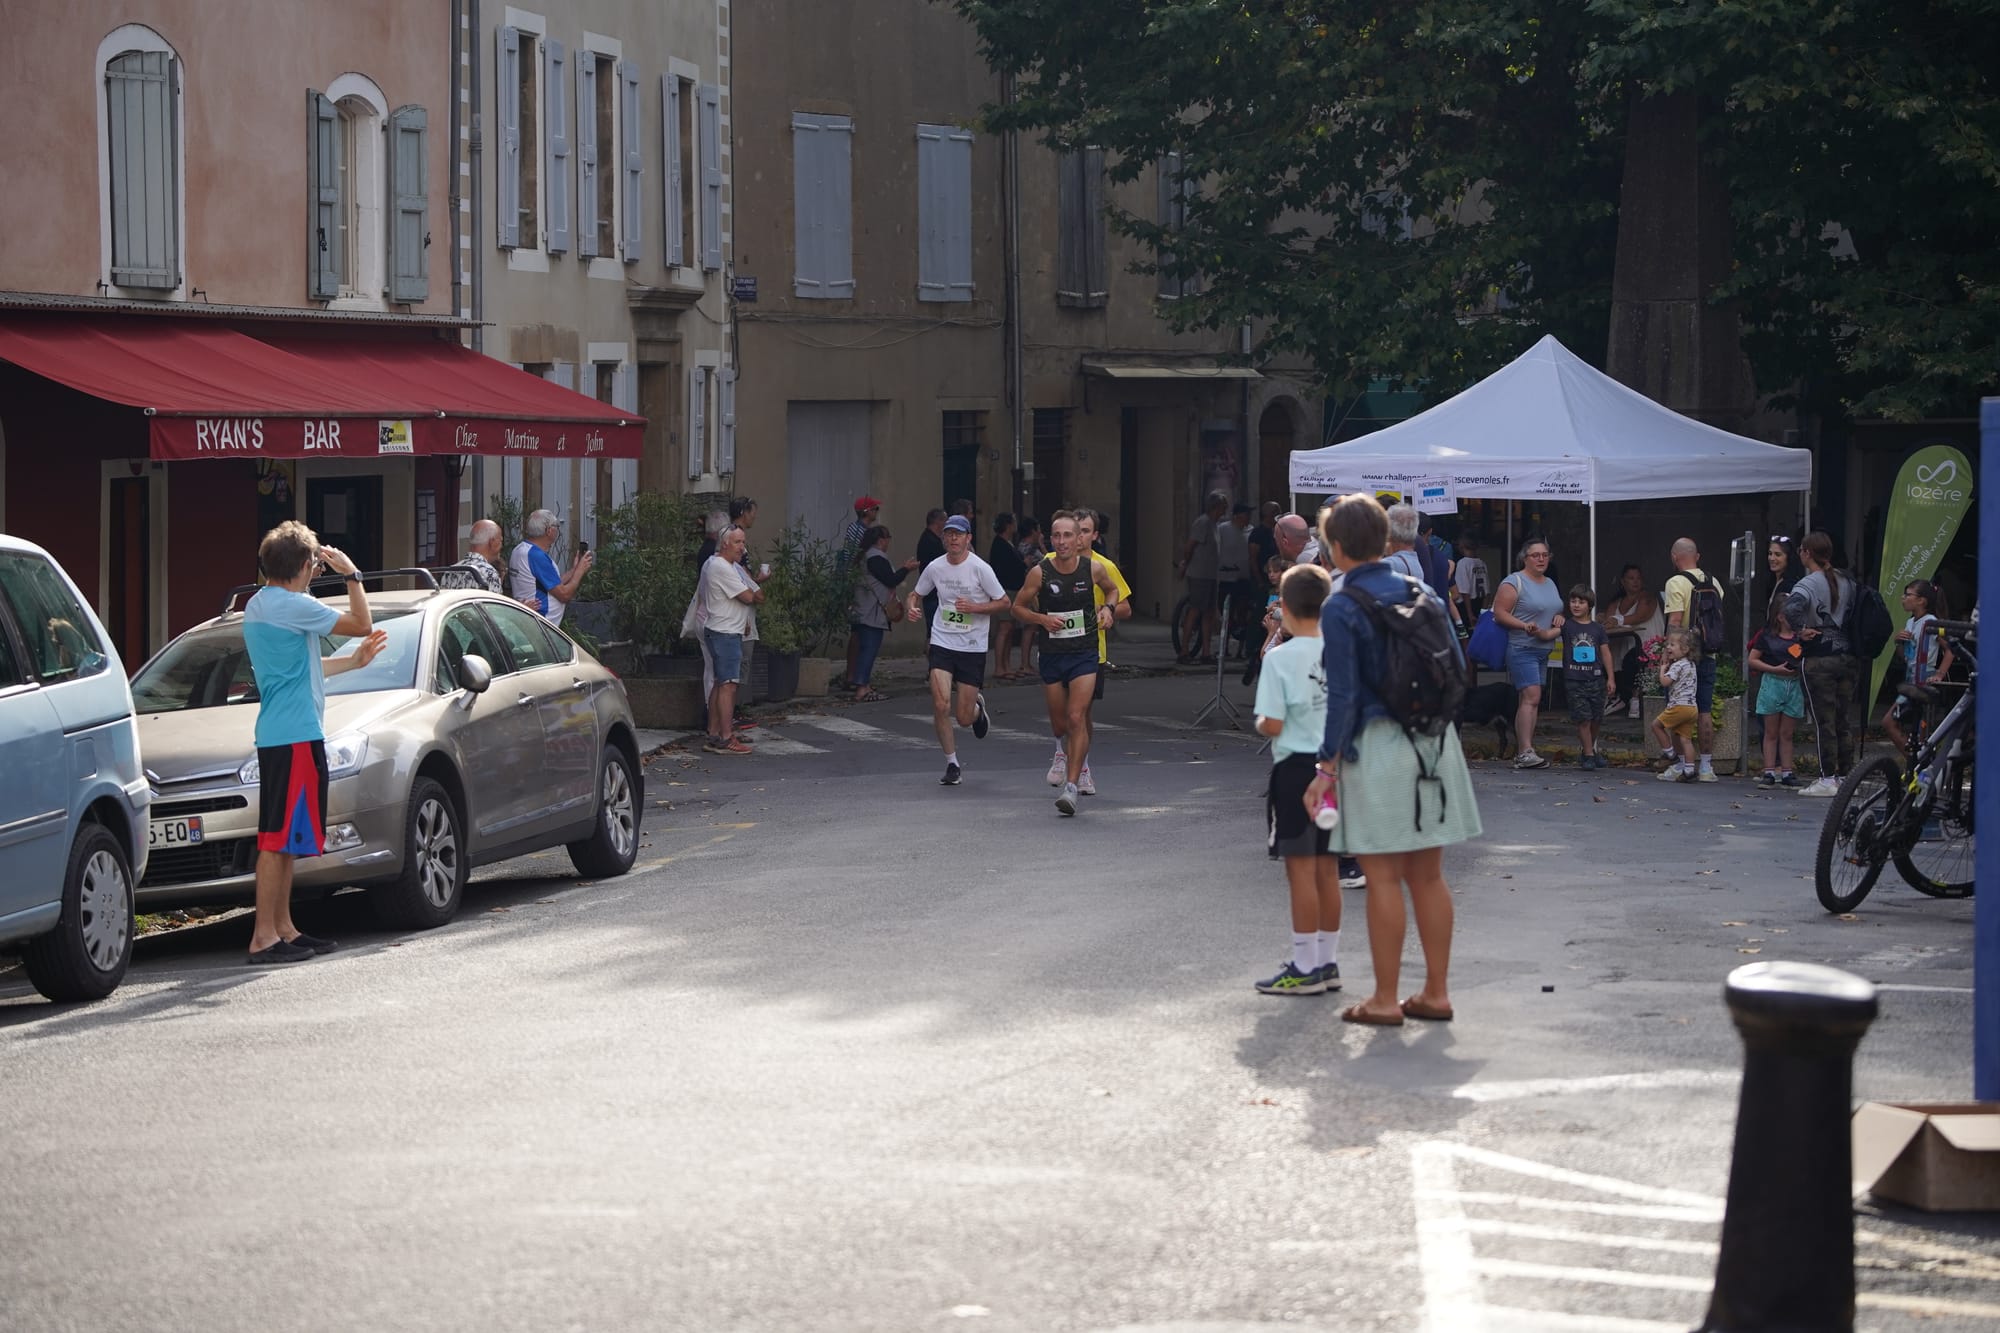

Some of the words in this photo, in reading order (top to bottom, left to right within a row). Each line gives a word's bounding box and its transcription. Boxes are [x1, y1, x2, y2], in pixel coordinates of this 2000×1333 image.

[196, 418, 264, 450] RYAN'S
[303, 420, 342, 450] BAR
[455, 423, 478, 448] Chez
[504, 427, 540, 450] Martine
[557, 433, 567, 451] et
[585, 429, 604, 455] John
[1907, 484, 1962, 501] lozère
[948, 612, 964, 623] 23
[191, 830, 201, 841] 48
